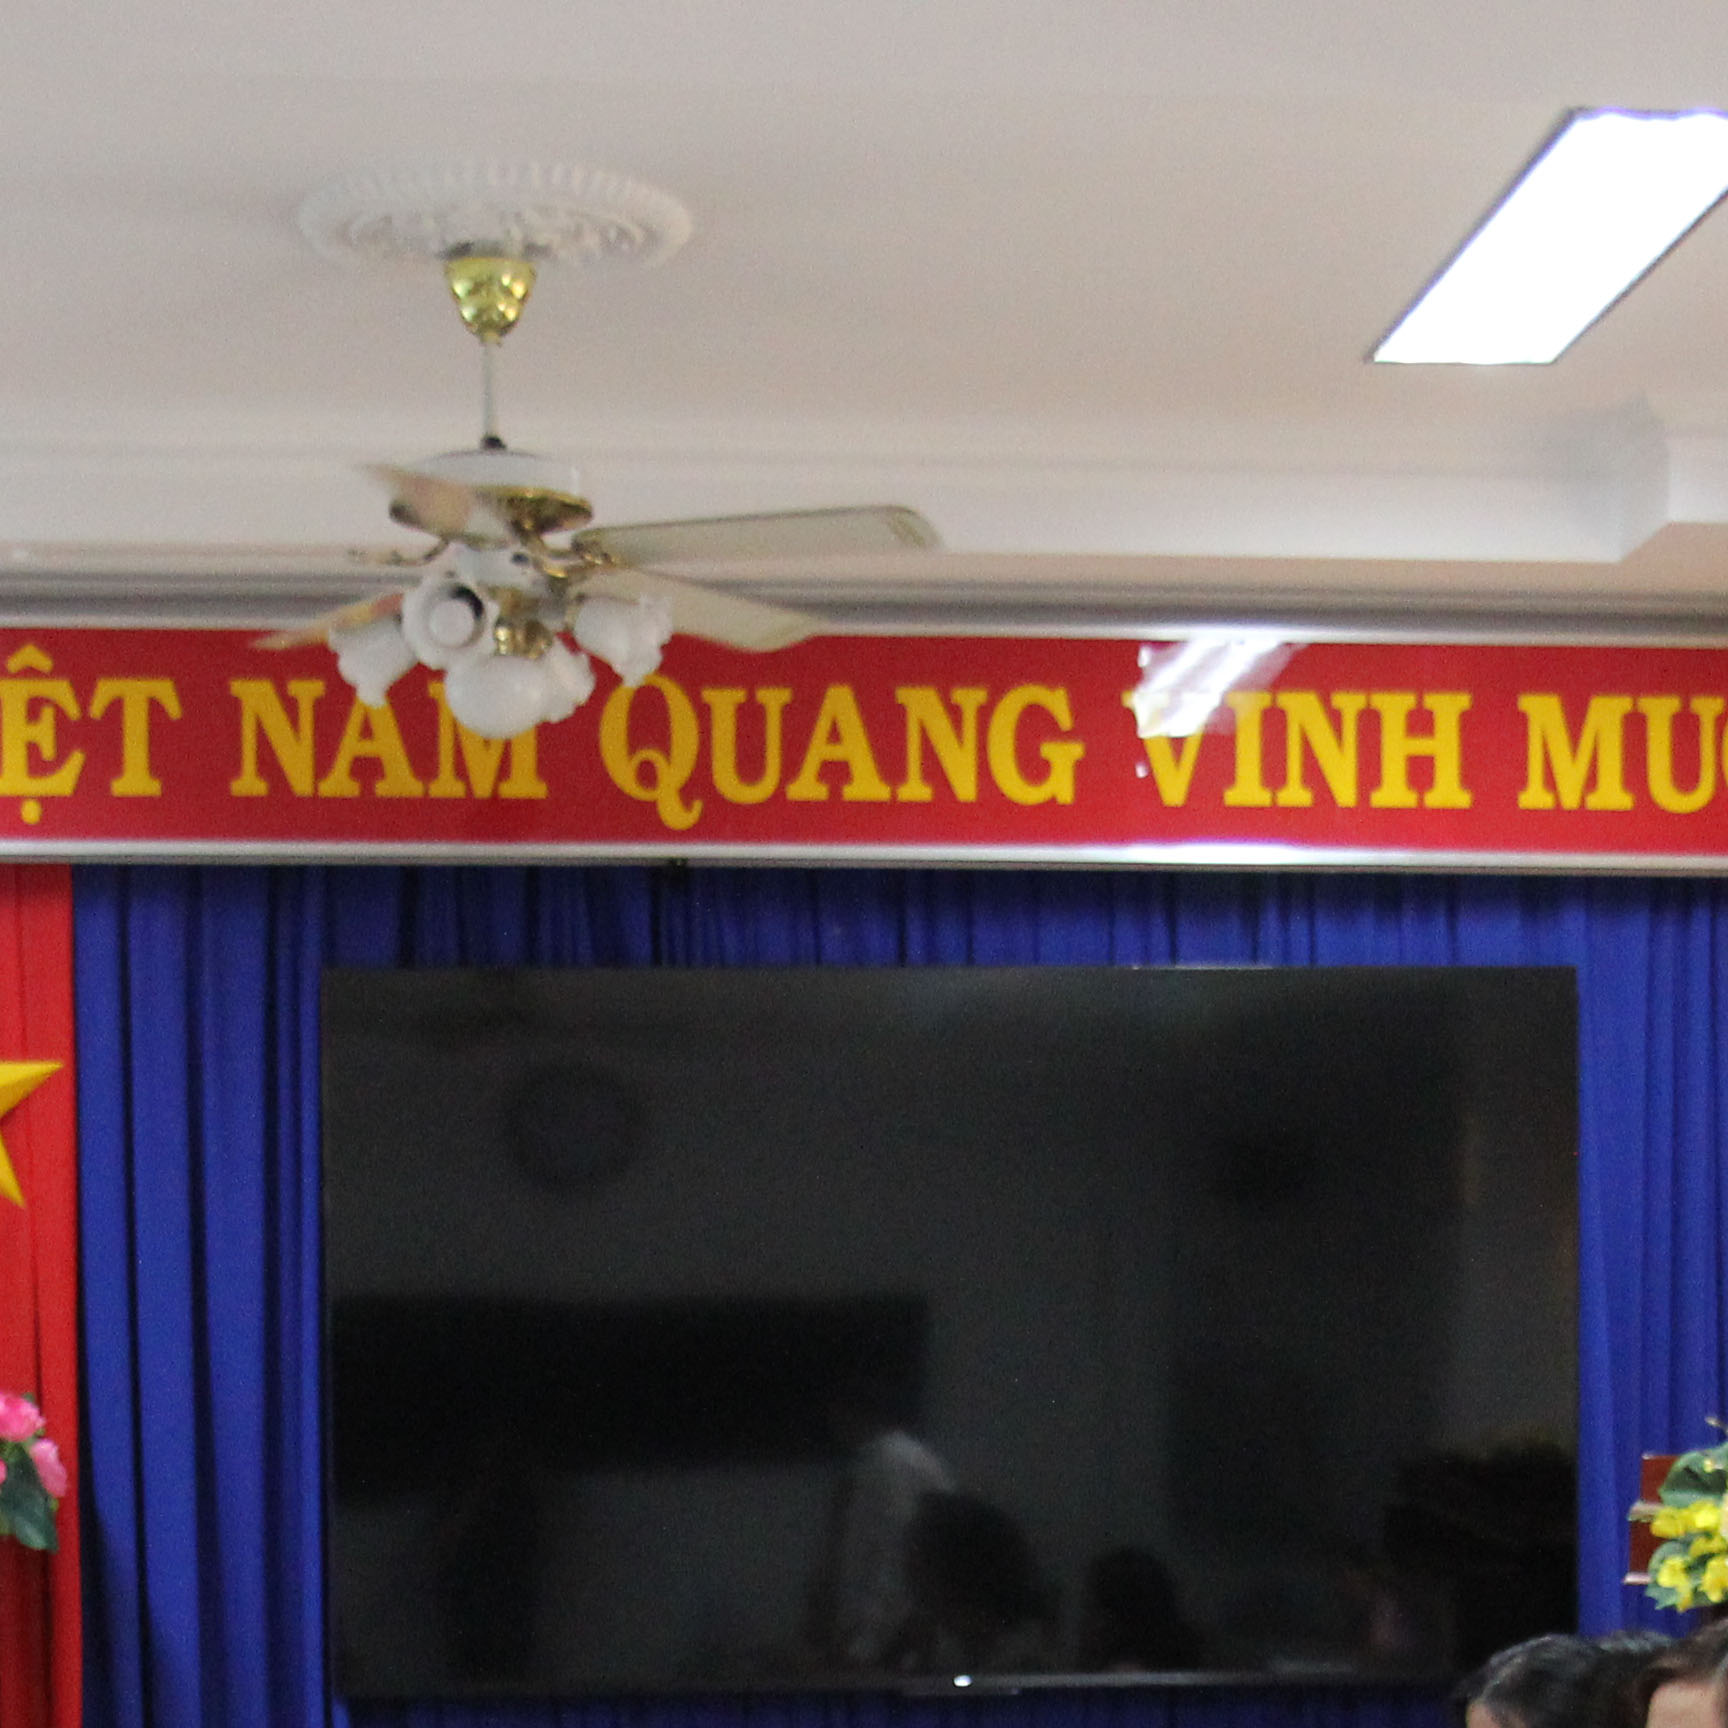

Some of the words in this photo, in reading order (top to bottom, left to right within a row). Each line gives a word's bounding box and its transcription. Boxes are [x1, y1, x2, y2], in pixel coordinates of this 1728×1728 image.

[230, 677, 549, 799] NAM
[598, 672, 1088, 831] QUANG
[1122, 687, 1475, 810] VINH
